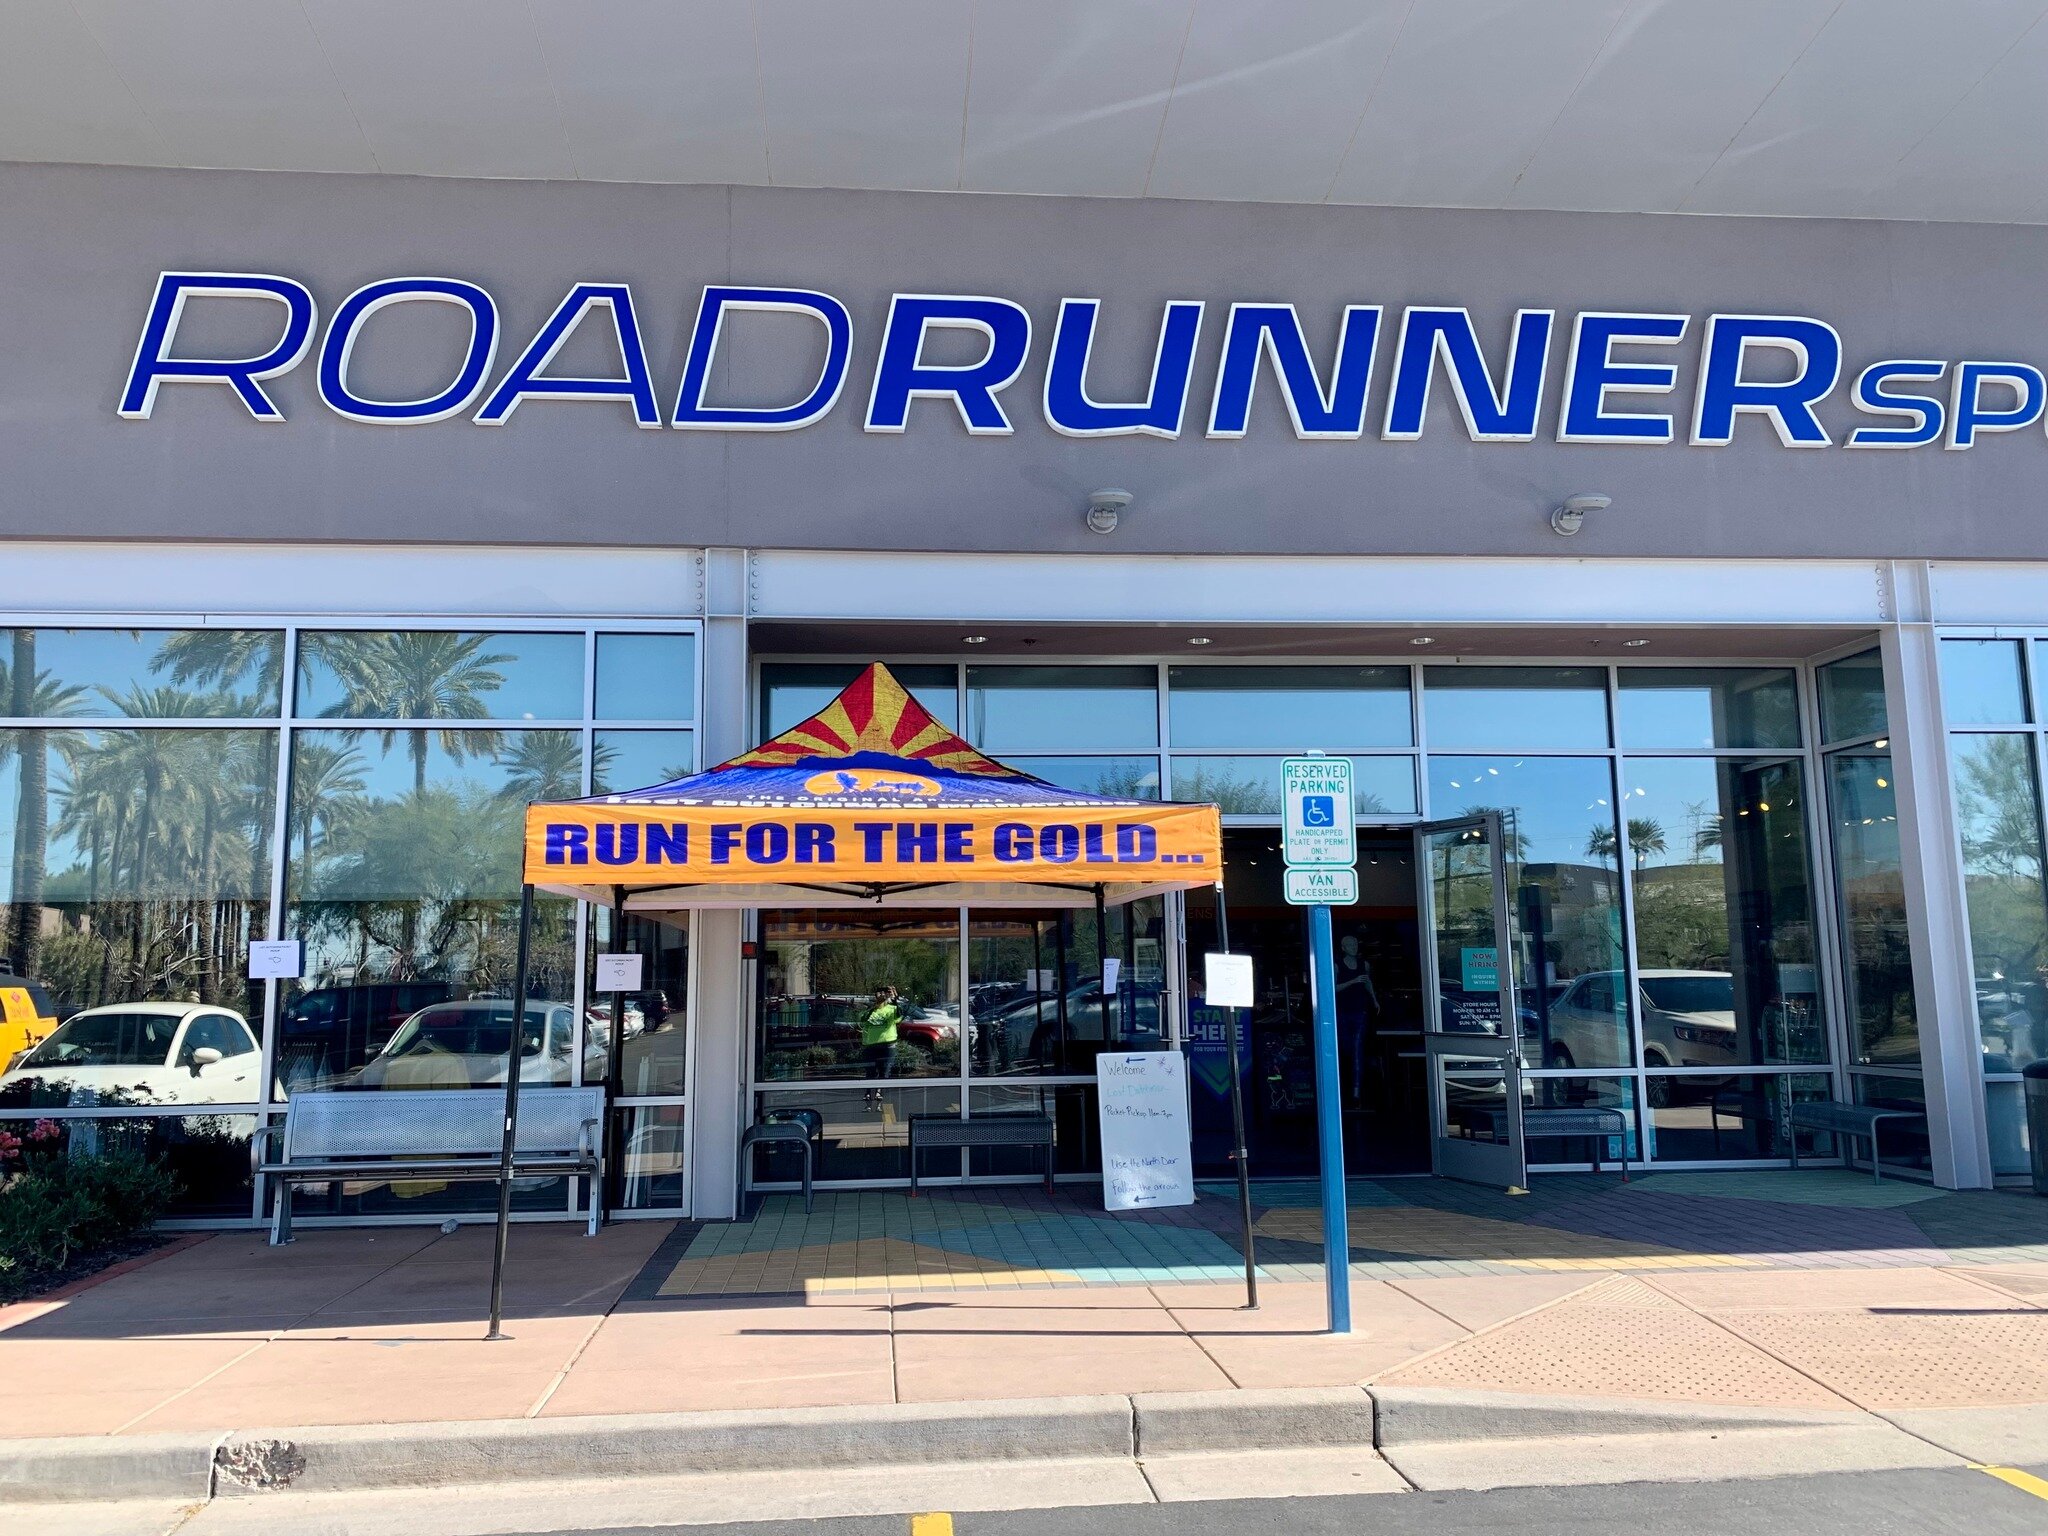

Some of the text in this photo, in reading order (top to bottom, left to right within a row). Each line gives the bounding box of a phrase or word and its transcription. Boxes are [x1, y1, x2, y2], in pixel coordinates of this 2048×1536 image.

[1843, 359, 2048, 450] SP
[1287, 765, 1347, 778] RESERVED
[1290, 780, 1344, 793] PARKING
[545, 822, 1204, 865] RUN FOR THE GOLD...
[1308, 875, 1334, 886] VAN
[1295, 888, 1349, 897] ACCESSIBLE
[1193, 1010, 1243, 1023] STAT
[1103, 1060, 1147, 1076] Welcome
[1111, 1156, 1179, 1170] Use the North Door
[1139, 1182, 1152, 1192] the
